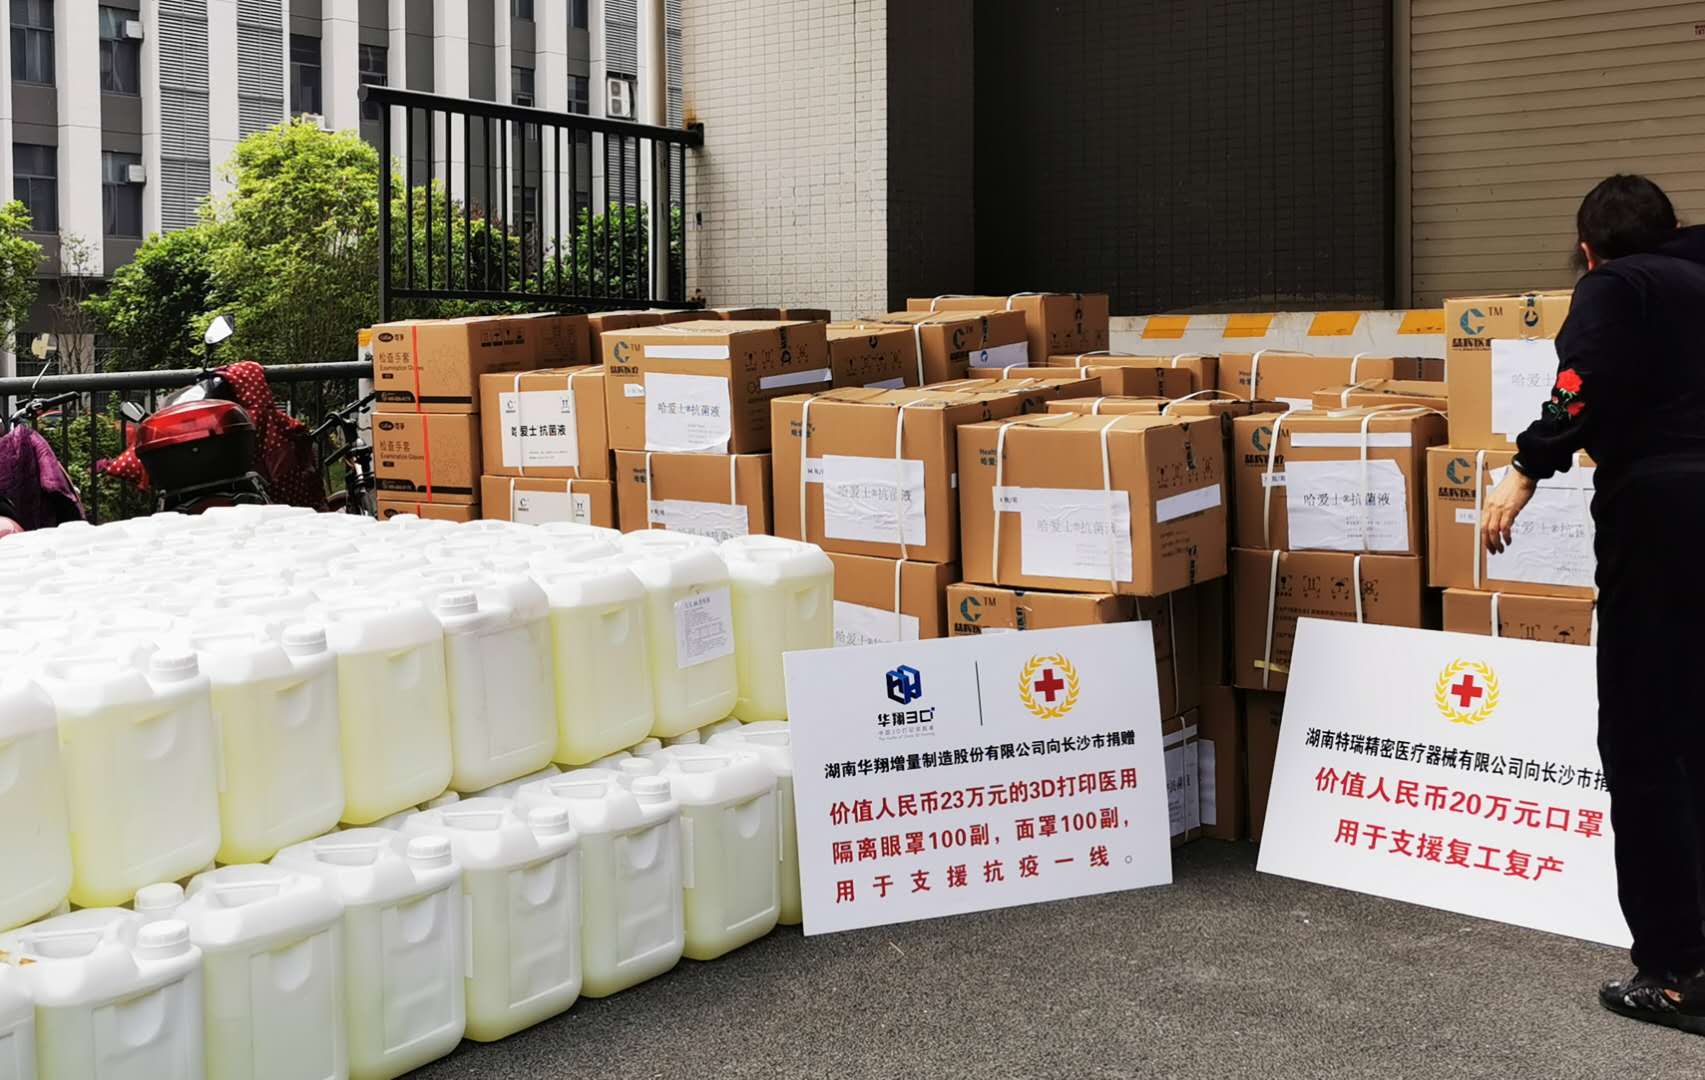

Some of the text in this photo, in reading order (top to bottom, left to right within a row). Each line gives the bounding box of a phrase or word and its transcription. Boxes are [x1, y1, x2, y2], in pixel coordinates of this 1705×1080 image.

[824, 730, 1135, 779] 湖南华翔增量制造股份有限公司向长沙市捐赠
[830, 768, 1137, 825] 价值人民币23万元的3D打印医用
[1315, 767, 1603, 838] 价值人民币20万元口罩
[1334, 819, 1564, 882] 用于支援复工复产
